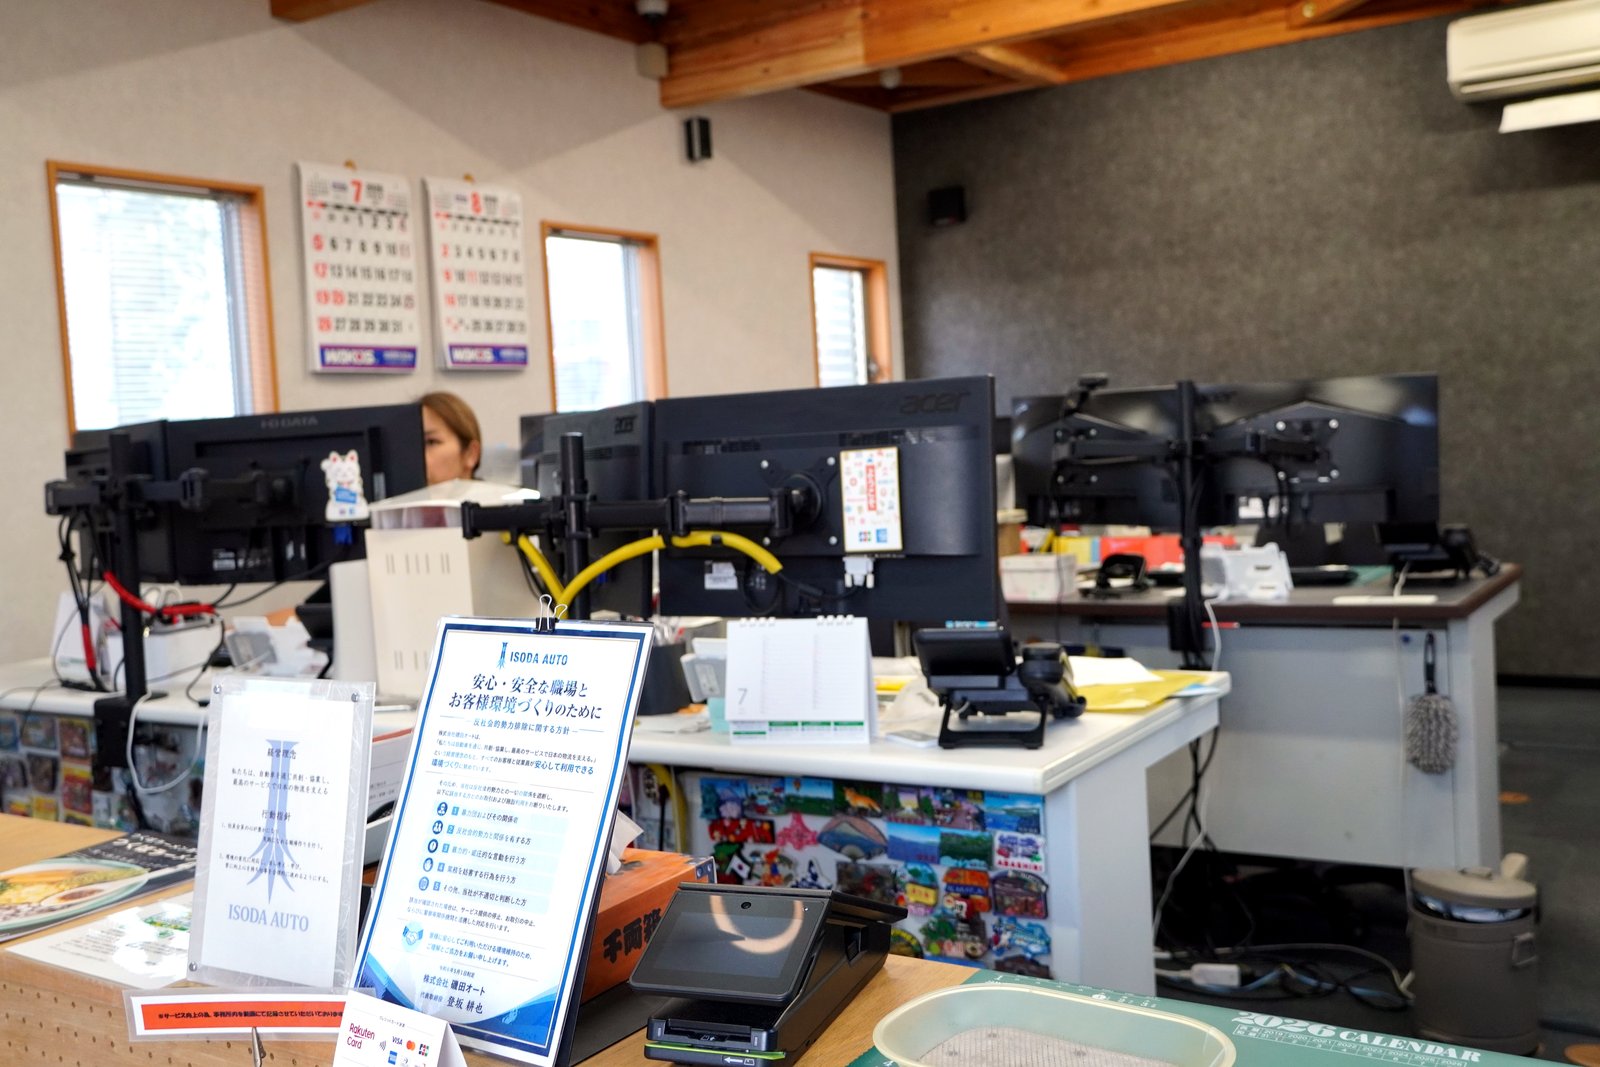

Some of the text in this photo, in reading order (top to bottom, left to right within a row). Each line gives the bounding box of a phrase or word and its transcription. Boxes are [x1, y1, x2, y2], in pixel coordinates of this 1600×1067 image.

[350, 180, 362, 203] 7
[471, 192, 483, 215] 8
[358, 213, 363, 226] 1
[900, 392, 971, 415] acer
[510, 652, 569, 666] ISODA AUTO
[472, 673, 588, 698] 安心・安全な職場と
[738, 688, 748, 705] 7
[448, 692, 602, 720] お客様環境づくりのために
[473, 718, 570, 735] 反社会的勢力排除に関する方針
[267, 748, 297, 760] 経営理念
[262, 810, 291, 822] 行動指針
[227, 904, 309, 933] ISODA AUTO
[423, 974, 485, 996] 株式会社 磯田オート
[349, 1023, 375, 1040] Rakuten
[1231, 1011, 1337, 1037] 2026
[1339, 1030, 1482, 1062] CALENDAR
[347, 1037, 362, 1049] Card
[392, 1036, 403, 1045] VISA
